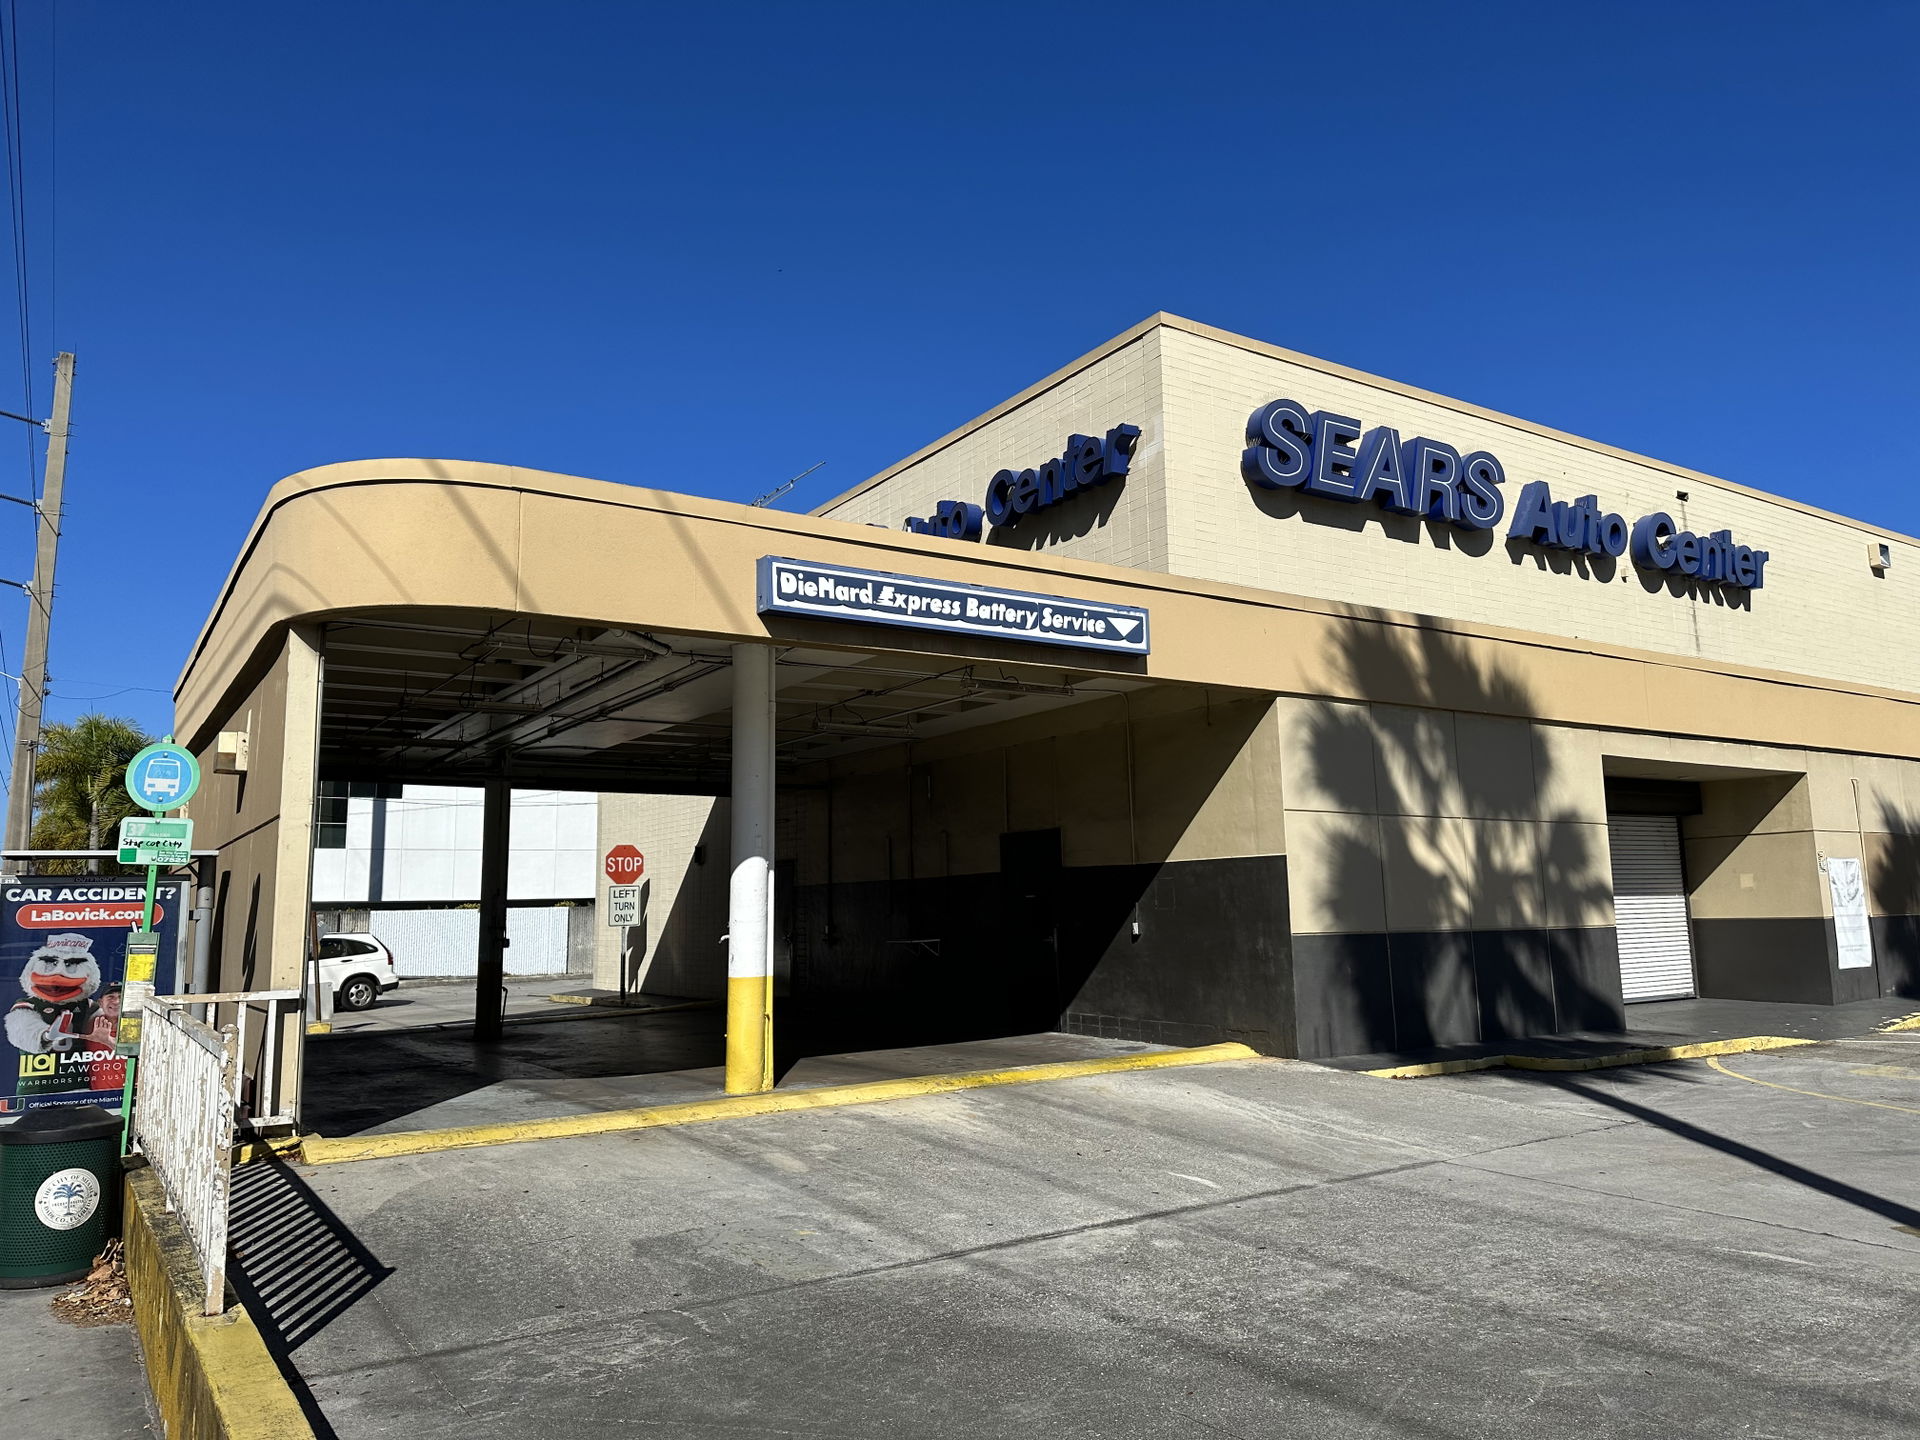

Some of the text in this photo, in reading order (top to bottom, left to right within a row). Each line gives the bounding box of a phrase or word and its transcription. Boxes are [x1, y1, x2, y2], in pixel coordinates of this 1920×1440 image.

[985, 422, 1142, 528] Center
[1241, 398, 1769, 589] SEARS Auto Center
[780, 571, 1106, 634] DieHard Express Battery Service
[607, 856, 643, 872] STOP
[5, 887, 177, 901] CAR ACCIDENT?
[613, 889, 636, 899] LEFT
[614, 902, 635, 911] TURN
[614, 914, 634, 923] ONLY
[60, 1050, 128, 1063] LABOV
[59, 1062, 127, 1074] LAWGRO
[18, 1078, 73, 1087] WARRIORS
[28, 1101, 53, 1109] Official
